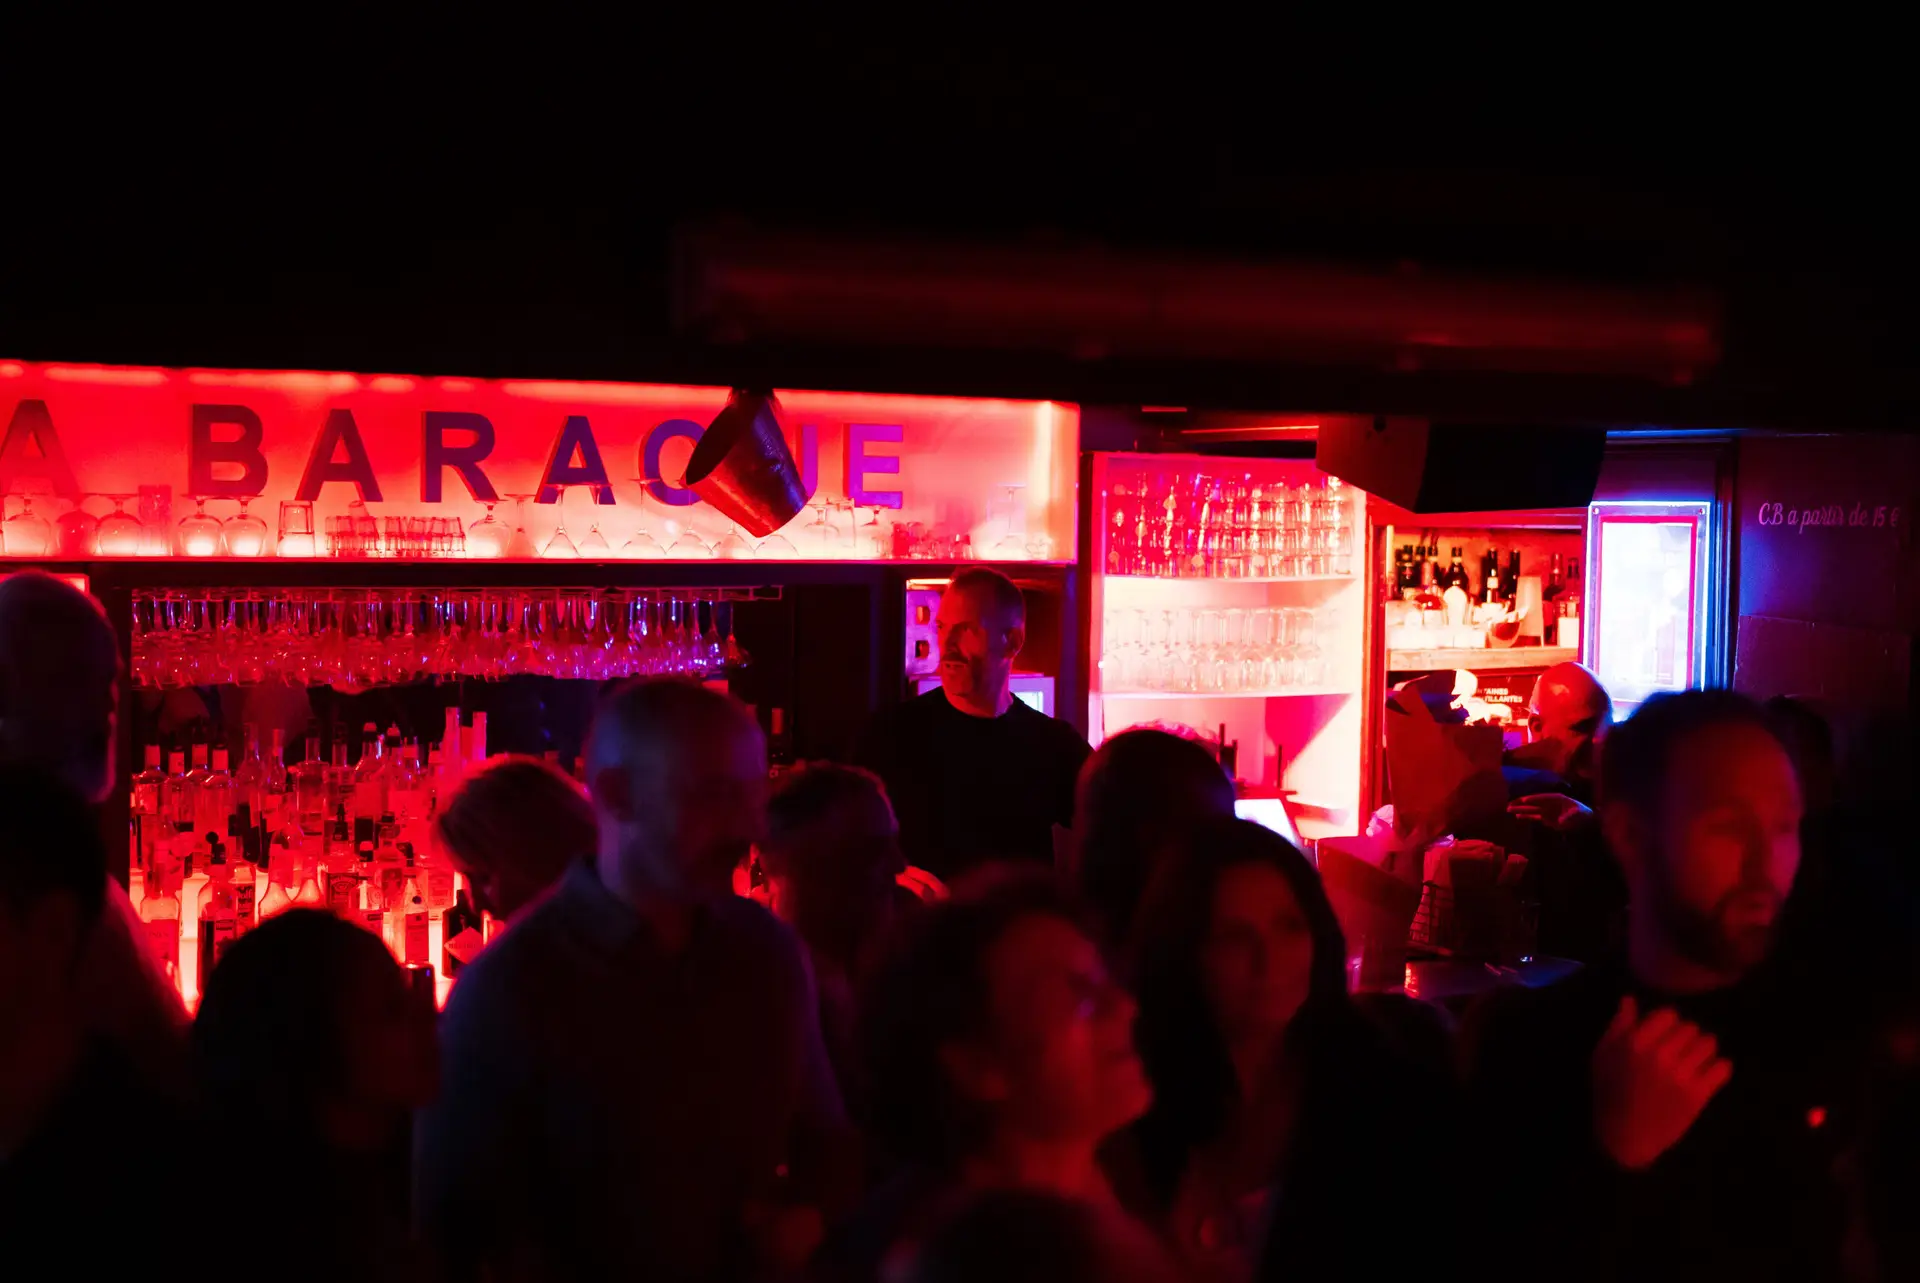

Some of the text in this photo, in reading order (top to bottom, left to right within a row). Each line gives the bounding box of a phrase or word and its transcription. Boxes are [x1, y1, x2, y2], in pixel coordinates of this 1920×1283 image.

[1758, 502, 1784, 526] CB
[1848, 501, 1868, 527] de
[1872, 505, 1888, 528] 15
